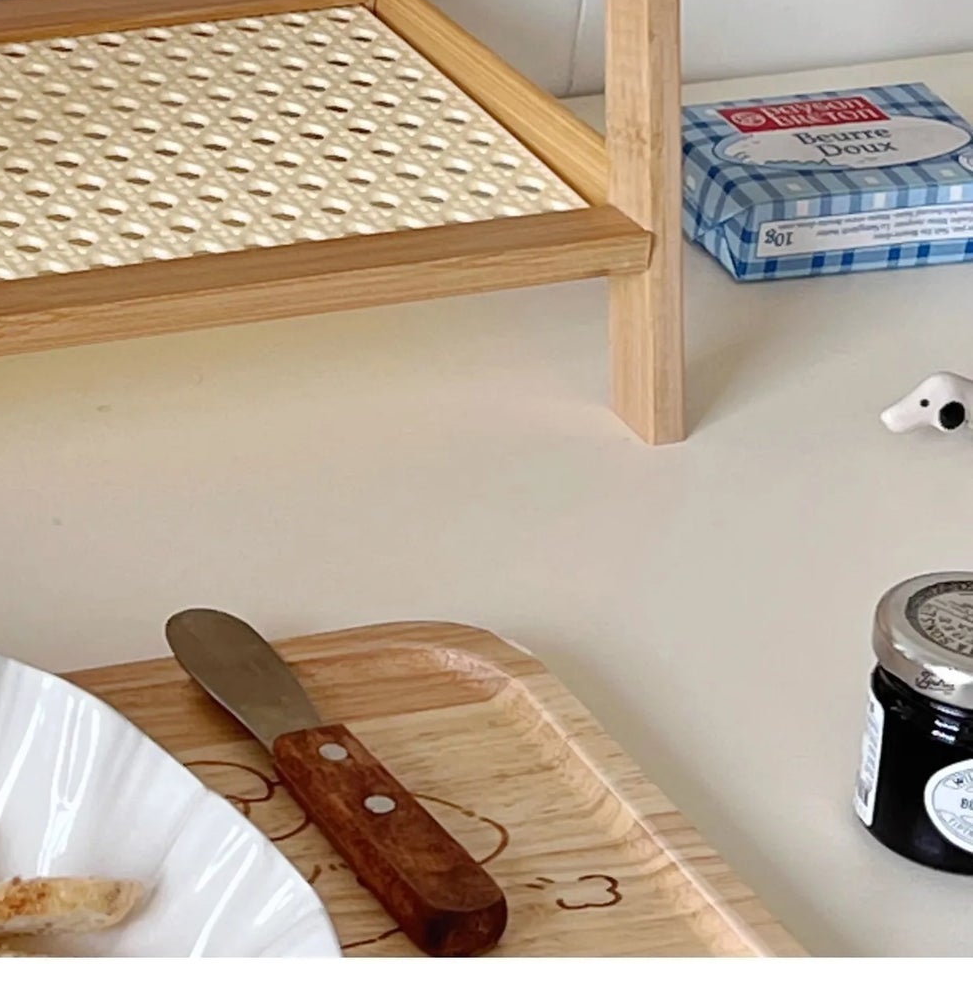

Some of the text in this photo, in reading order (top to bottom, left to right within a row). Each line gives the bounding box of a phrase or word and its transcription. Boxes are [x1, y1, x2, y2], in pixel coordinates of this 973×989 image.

[792, 128, 892, 145] Beurre
[816, 141, 898, 158] Doux
[763, 228, 794, 247] 10g
